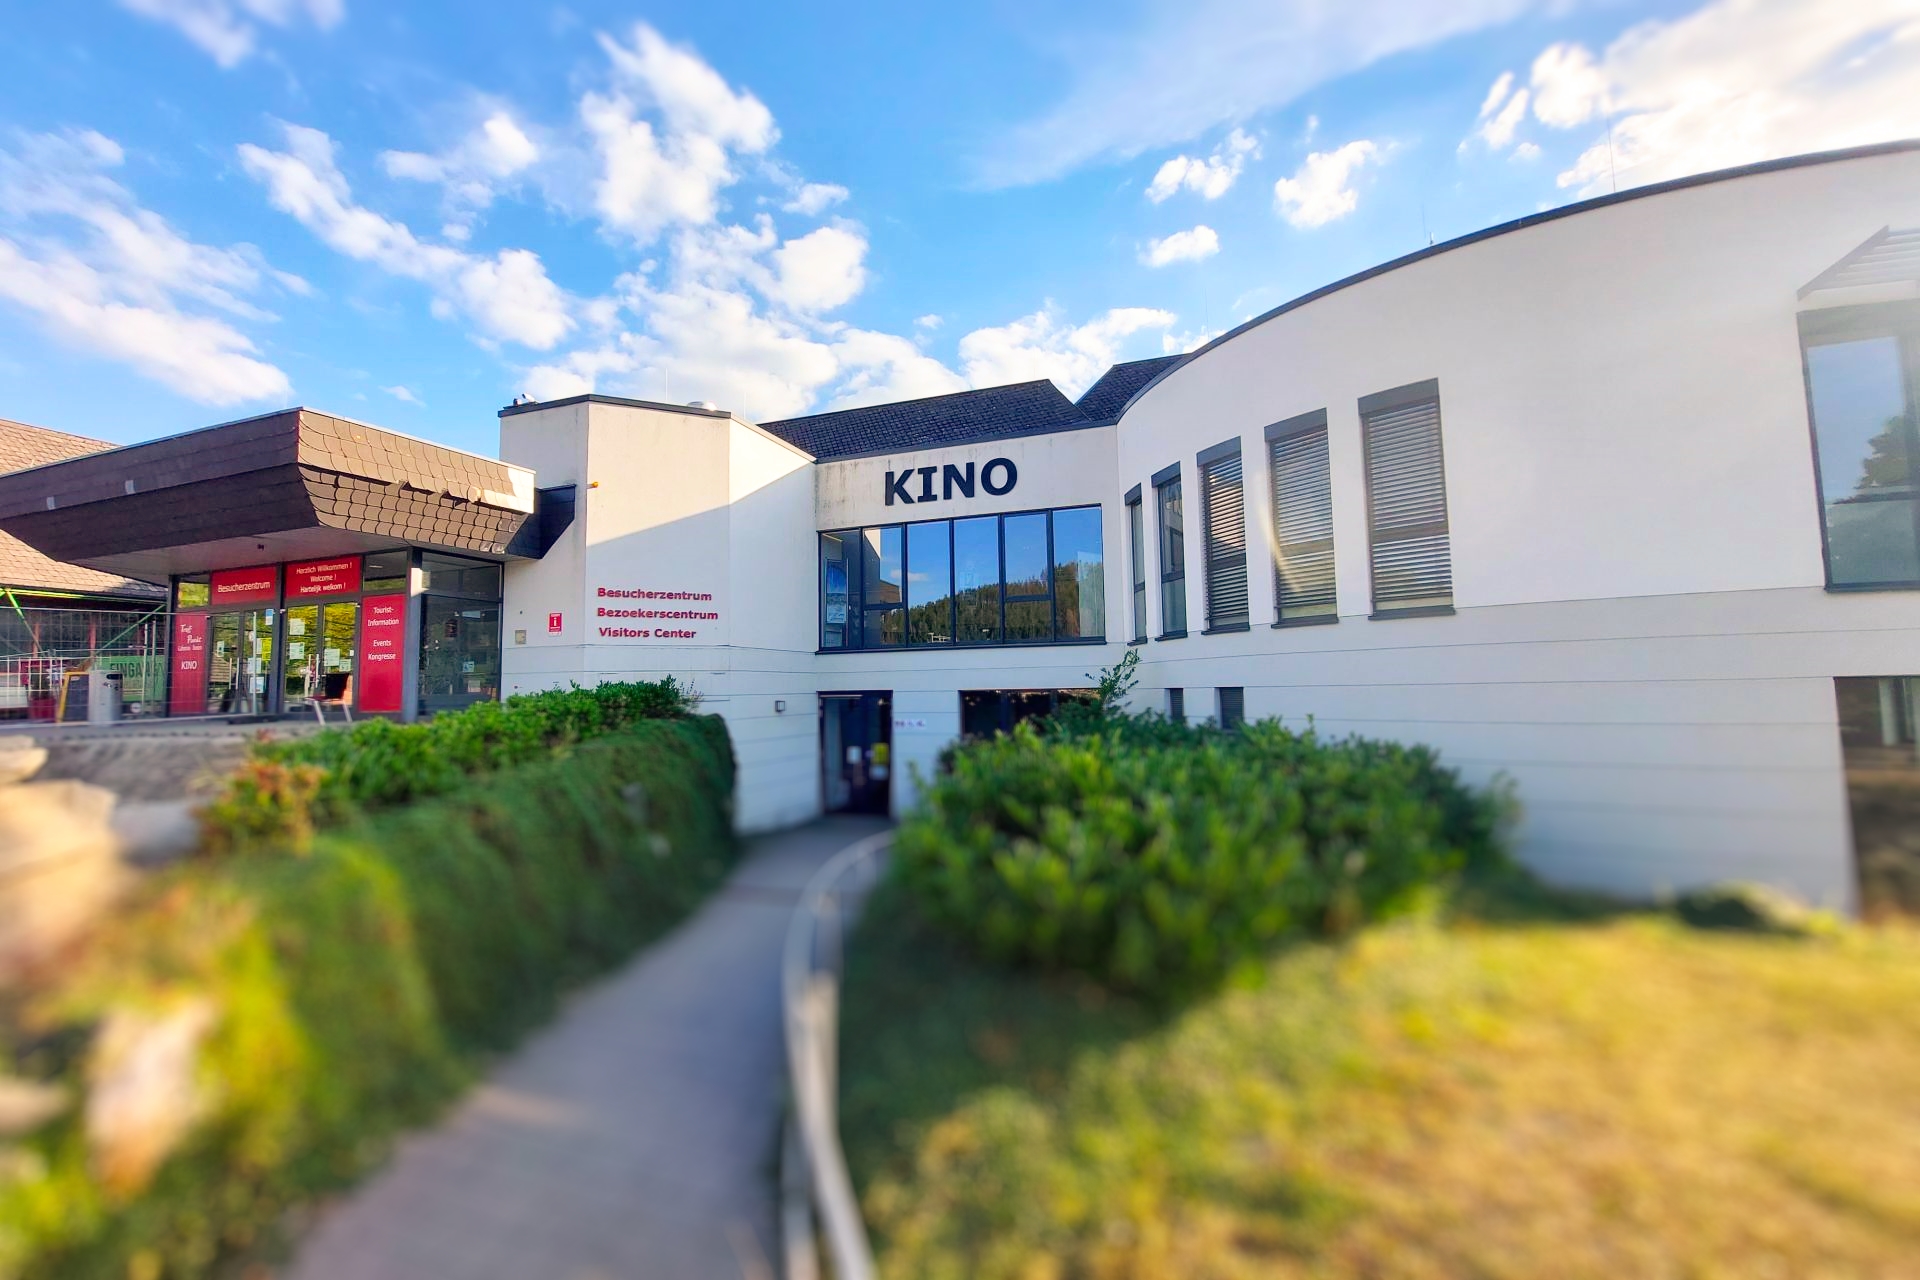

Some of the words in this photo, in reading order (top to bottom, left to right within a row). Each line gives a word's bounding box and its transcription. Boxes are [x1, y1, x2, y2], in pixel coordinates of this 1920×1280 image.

[885, 457, 1018, 506] KINO
[296, 566, 317, 574] Herzlich
[317, 563, 349, 572] Willkommen
[310, 575, 334, 583] Welcome
[217, 581, 271, 593] Besucherzentrum
[322, 583, 343, 591] welkom
[597, 587, 713, 602] Besucherzentrum
[373, 606, 394, 614] Tourist-
[597, 607, 719, 621] Bezoekerscentrum
[368, 618, 400, 627] Information
[599, 627, 650, 638] Visitors
[654, 628, 697, 639] Center
[373, 639, 392, 647] Events
[368, 652, 396, 661] Kongresse
[181, 660, 198, 670] KINO
